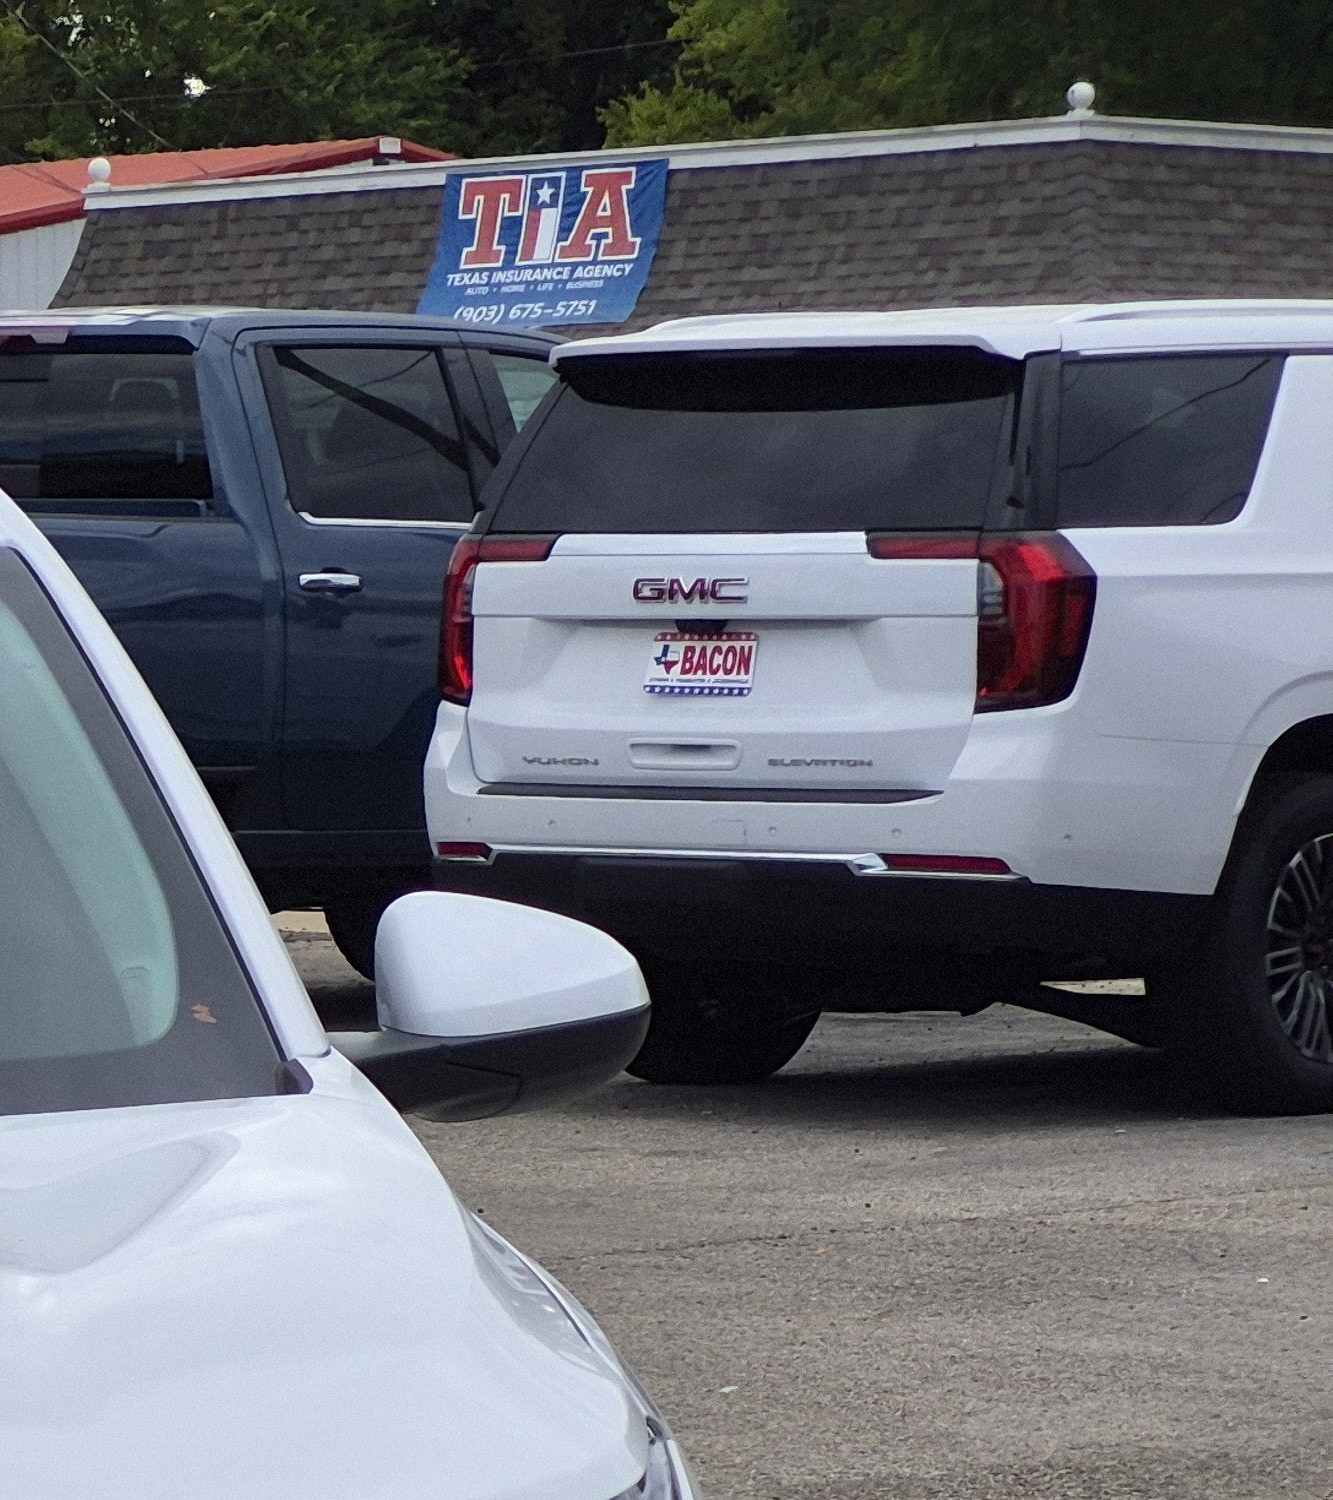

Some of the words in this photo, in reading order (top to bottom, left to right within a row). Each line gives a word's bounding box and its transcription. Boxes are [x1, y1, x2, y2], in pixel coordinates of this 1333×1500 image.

[446, 271, 488, 287] TEXAS
[491, 266, 570, 284] INSURANCE
[573, 263, 634, 279] AGENCY
[465, 287, 489, 296] AUTO
[536, 282, 553, 291] LIFE
[453, 303, 505, 325] (903)
[508, 299, 598, 321] 675-5751
[633, 577, 749, 604] GMC
[680, 645, 753, 676] BACON
